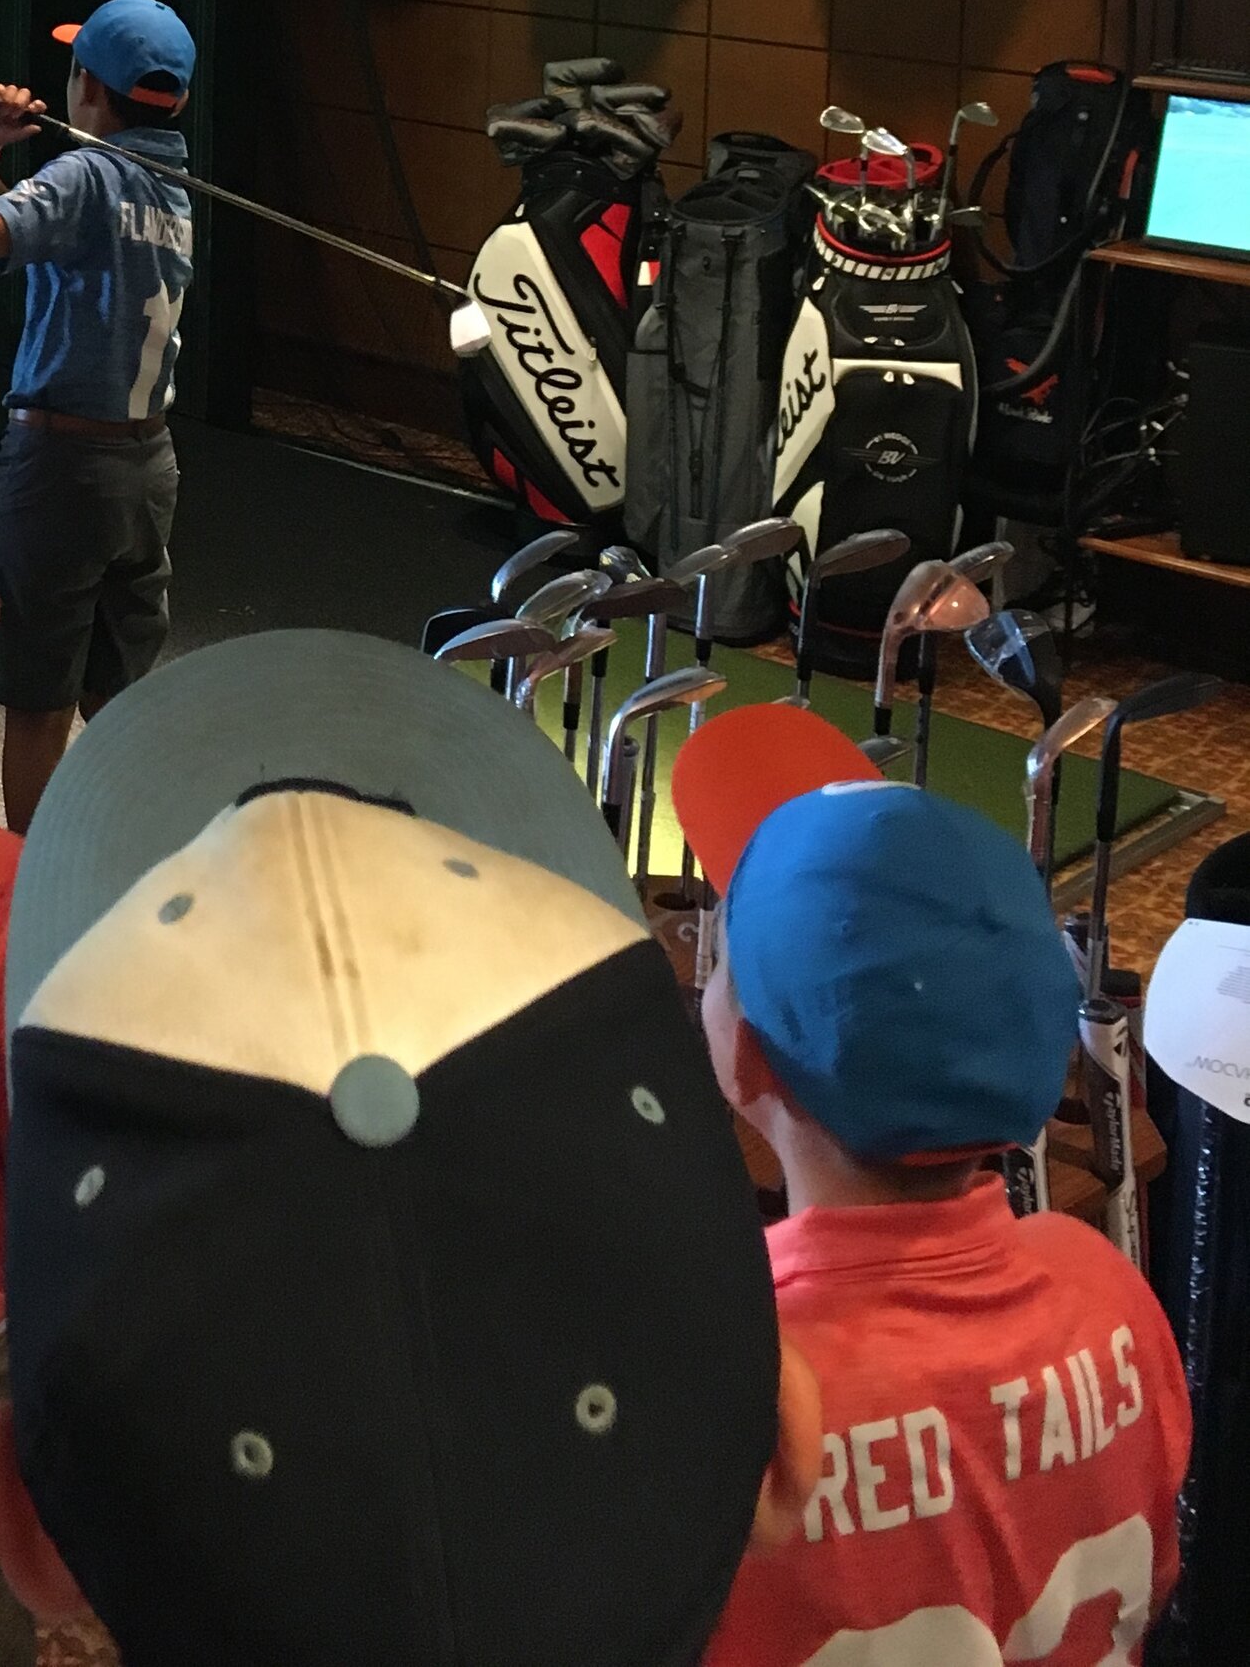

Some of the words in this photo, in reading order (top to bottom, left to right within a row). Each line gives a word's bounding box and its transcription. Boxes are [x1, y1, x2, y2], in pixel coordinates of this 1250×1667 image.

[474, 272, 621, 488] Titleist
[777, 348, 826, 456] eist
[1102, 1091, 1123, 1172] TaylorMade
[803, 1406, 954, 1542] RED
[990, 1324, 1143, 1480] TAILS
